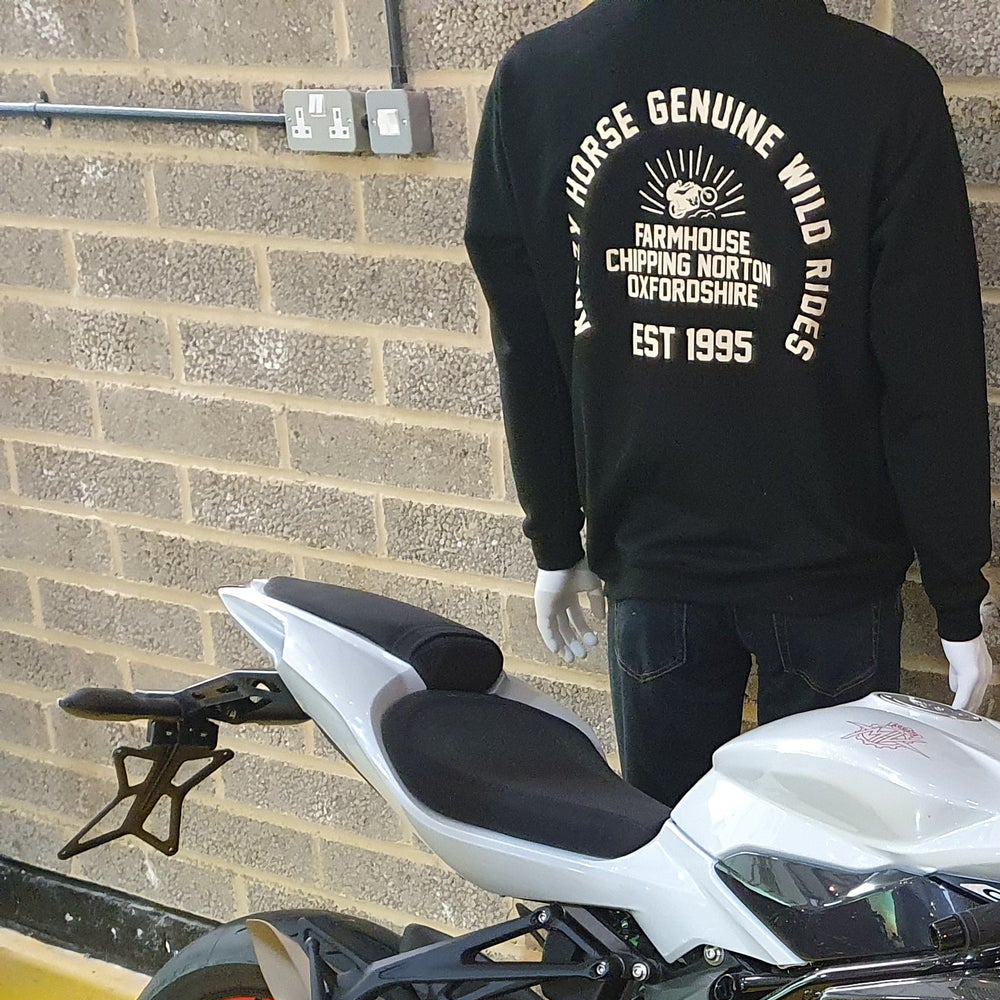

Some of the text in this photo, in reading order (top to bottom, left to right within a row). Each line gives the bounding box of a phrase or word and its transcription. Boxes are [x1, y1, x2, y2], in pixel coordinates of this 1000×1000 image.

[647, 86, 784, 160] GENUINE
[565, 101, 639, 207] HORSE
[777, 153, 832, 245] WILD
[605, 248, 771, 288] CHIPPING NORTON
[635, 222, 750, 256] FARMHOUSE
[627, 274, 759, 309] OXFORDSHIRE
[785, 257, 832, 362] RIDES
[632, 322, 753, 364] EST 1995
